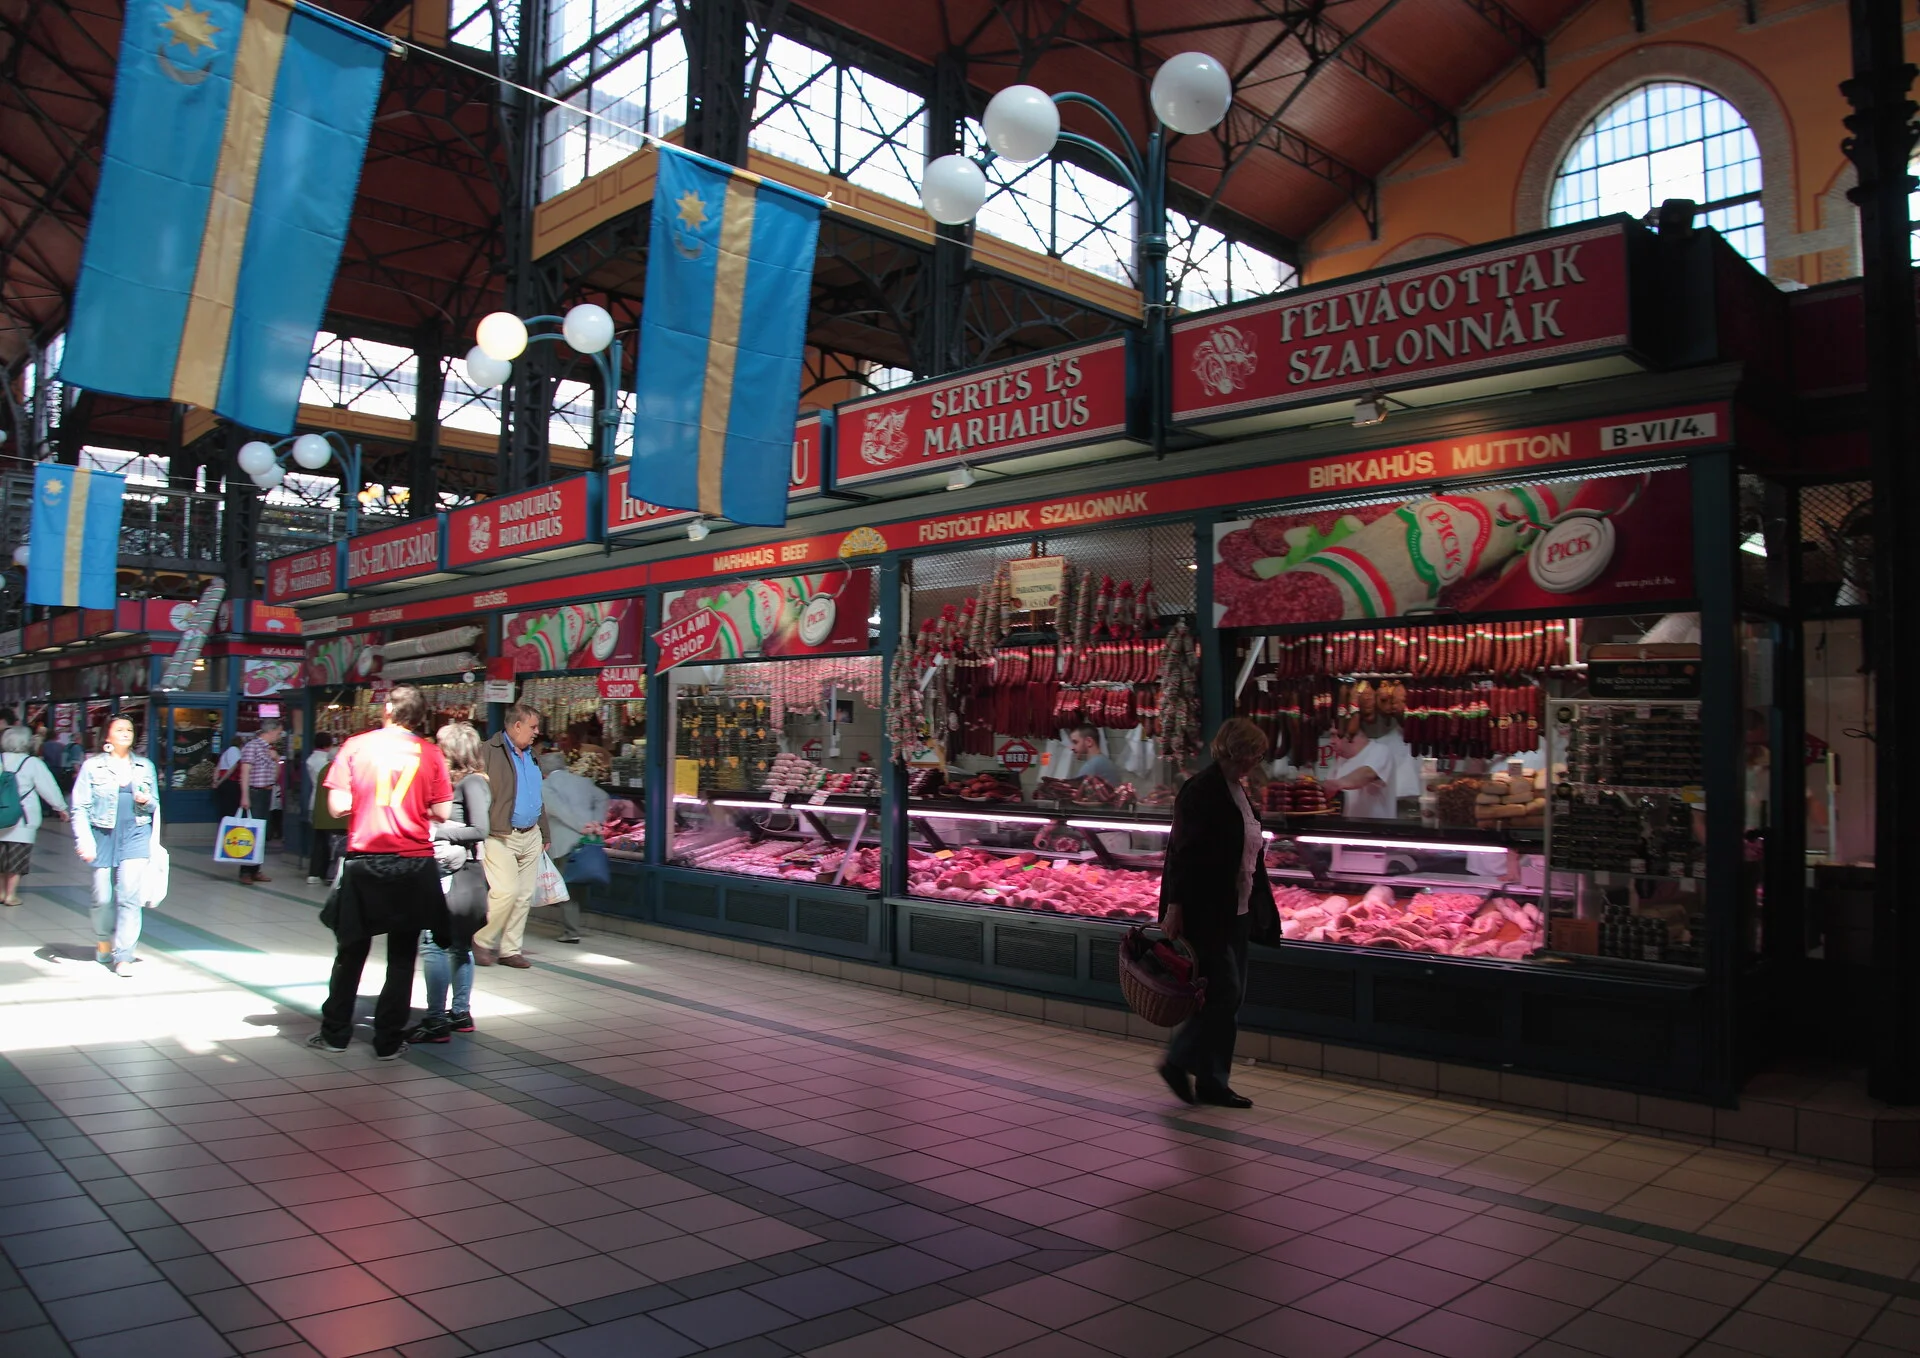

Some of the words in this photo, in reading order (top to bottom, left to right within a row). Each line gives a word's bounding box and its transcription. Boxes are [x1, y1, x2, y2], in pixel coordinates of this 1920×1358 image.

[1280, 245, 1585, 344] FELVÁGOTTAK
[1288, 298, 1565, 386] SZALONNÁK
[930, 368, 1033, 421] SERTÉS
[1045, 355, 1084, 394] ÉS
[922, 389, 1091, 457] MARHAHÚS
[1452, 432, 1571, 470] MUTTON
[919, 515, 983, 543] FÜSTÖLT
[1039, 490, 1149, 526] SZALONNÁK
[781, 543, 809, 562] BEEF
[1427, 509, 1463, 572] PICK
[1546, 531, 1591, 565] PICK
[662, 611, 711, 648] SALAMI
[671, 635, 706, 661] SHOP
[607, 684, 635, 698] SHOP
